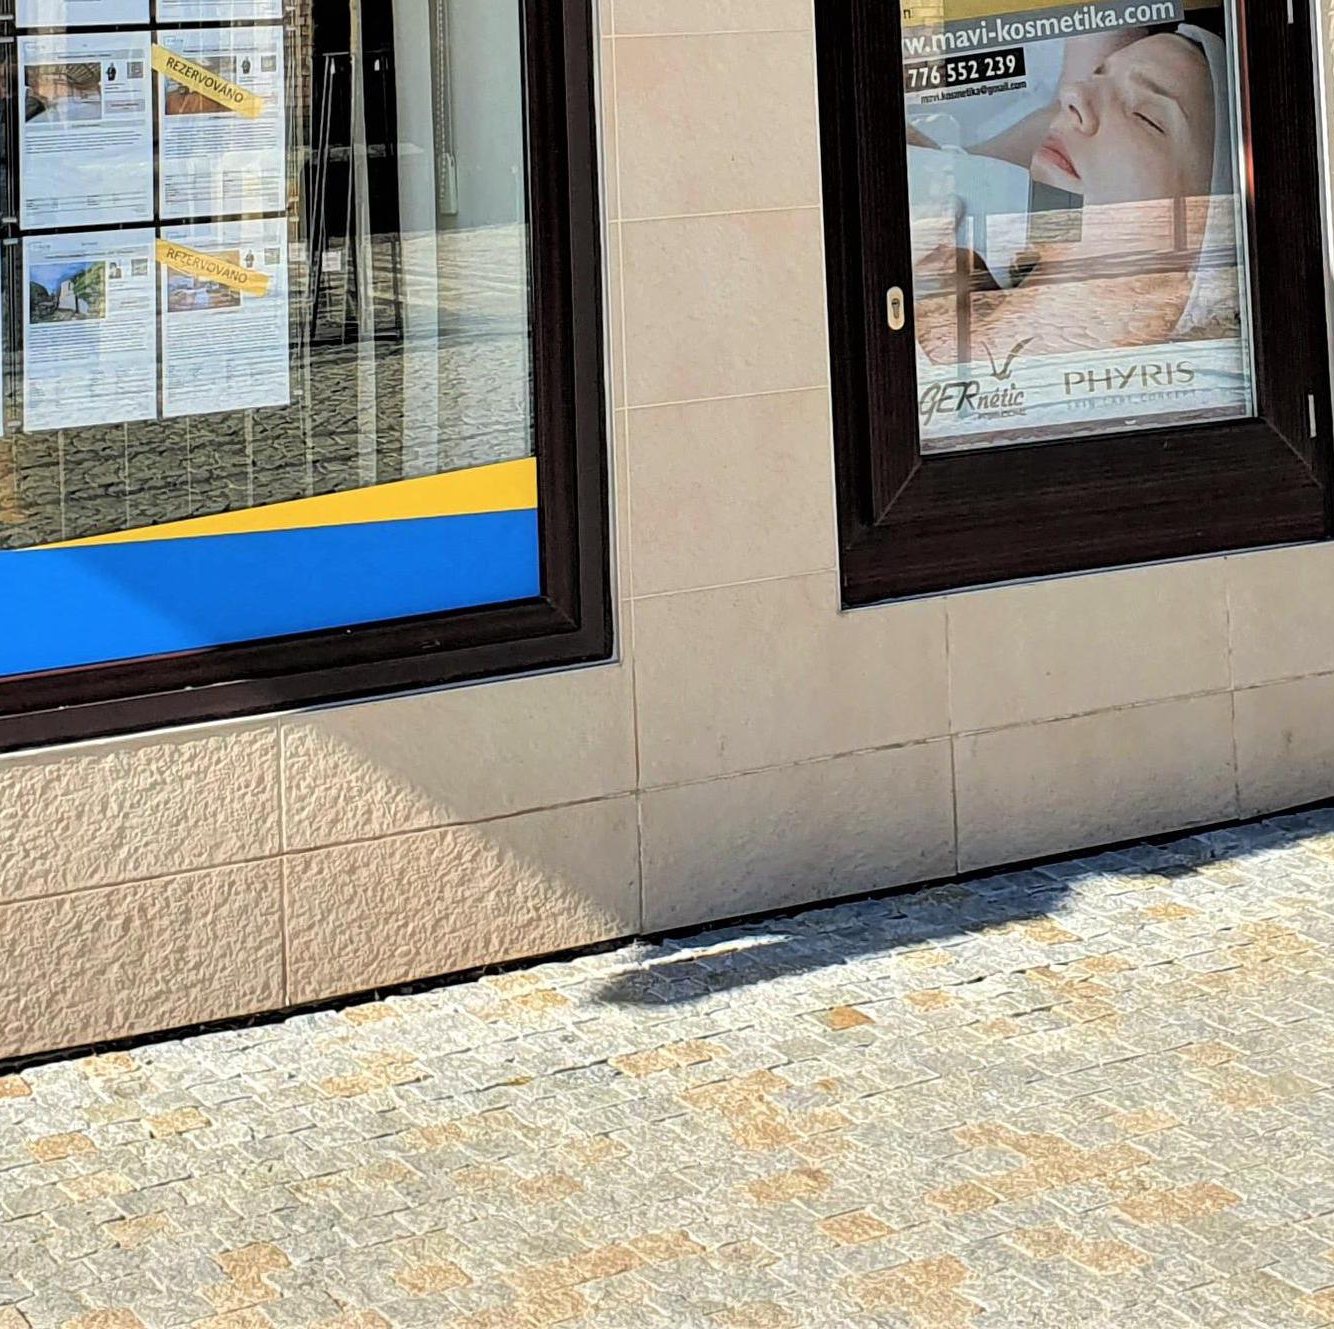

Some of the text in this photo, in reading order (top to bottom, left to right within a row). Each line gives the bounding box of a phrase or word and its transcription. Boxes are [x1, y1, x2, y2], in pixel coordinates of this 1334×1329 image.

[165, 56, 244, 104] REZERVOVÁNO
[908, 54, 1016, 88] 776 552 239
[1063, 360, 1195, 395] PHYRIS
